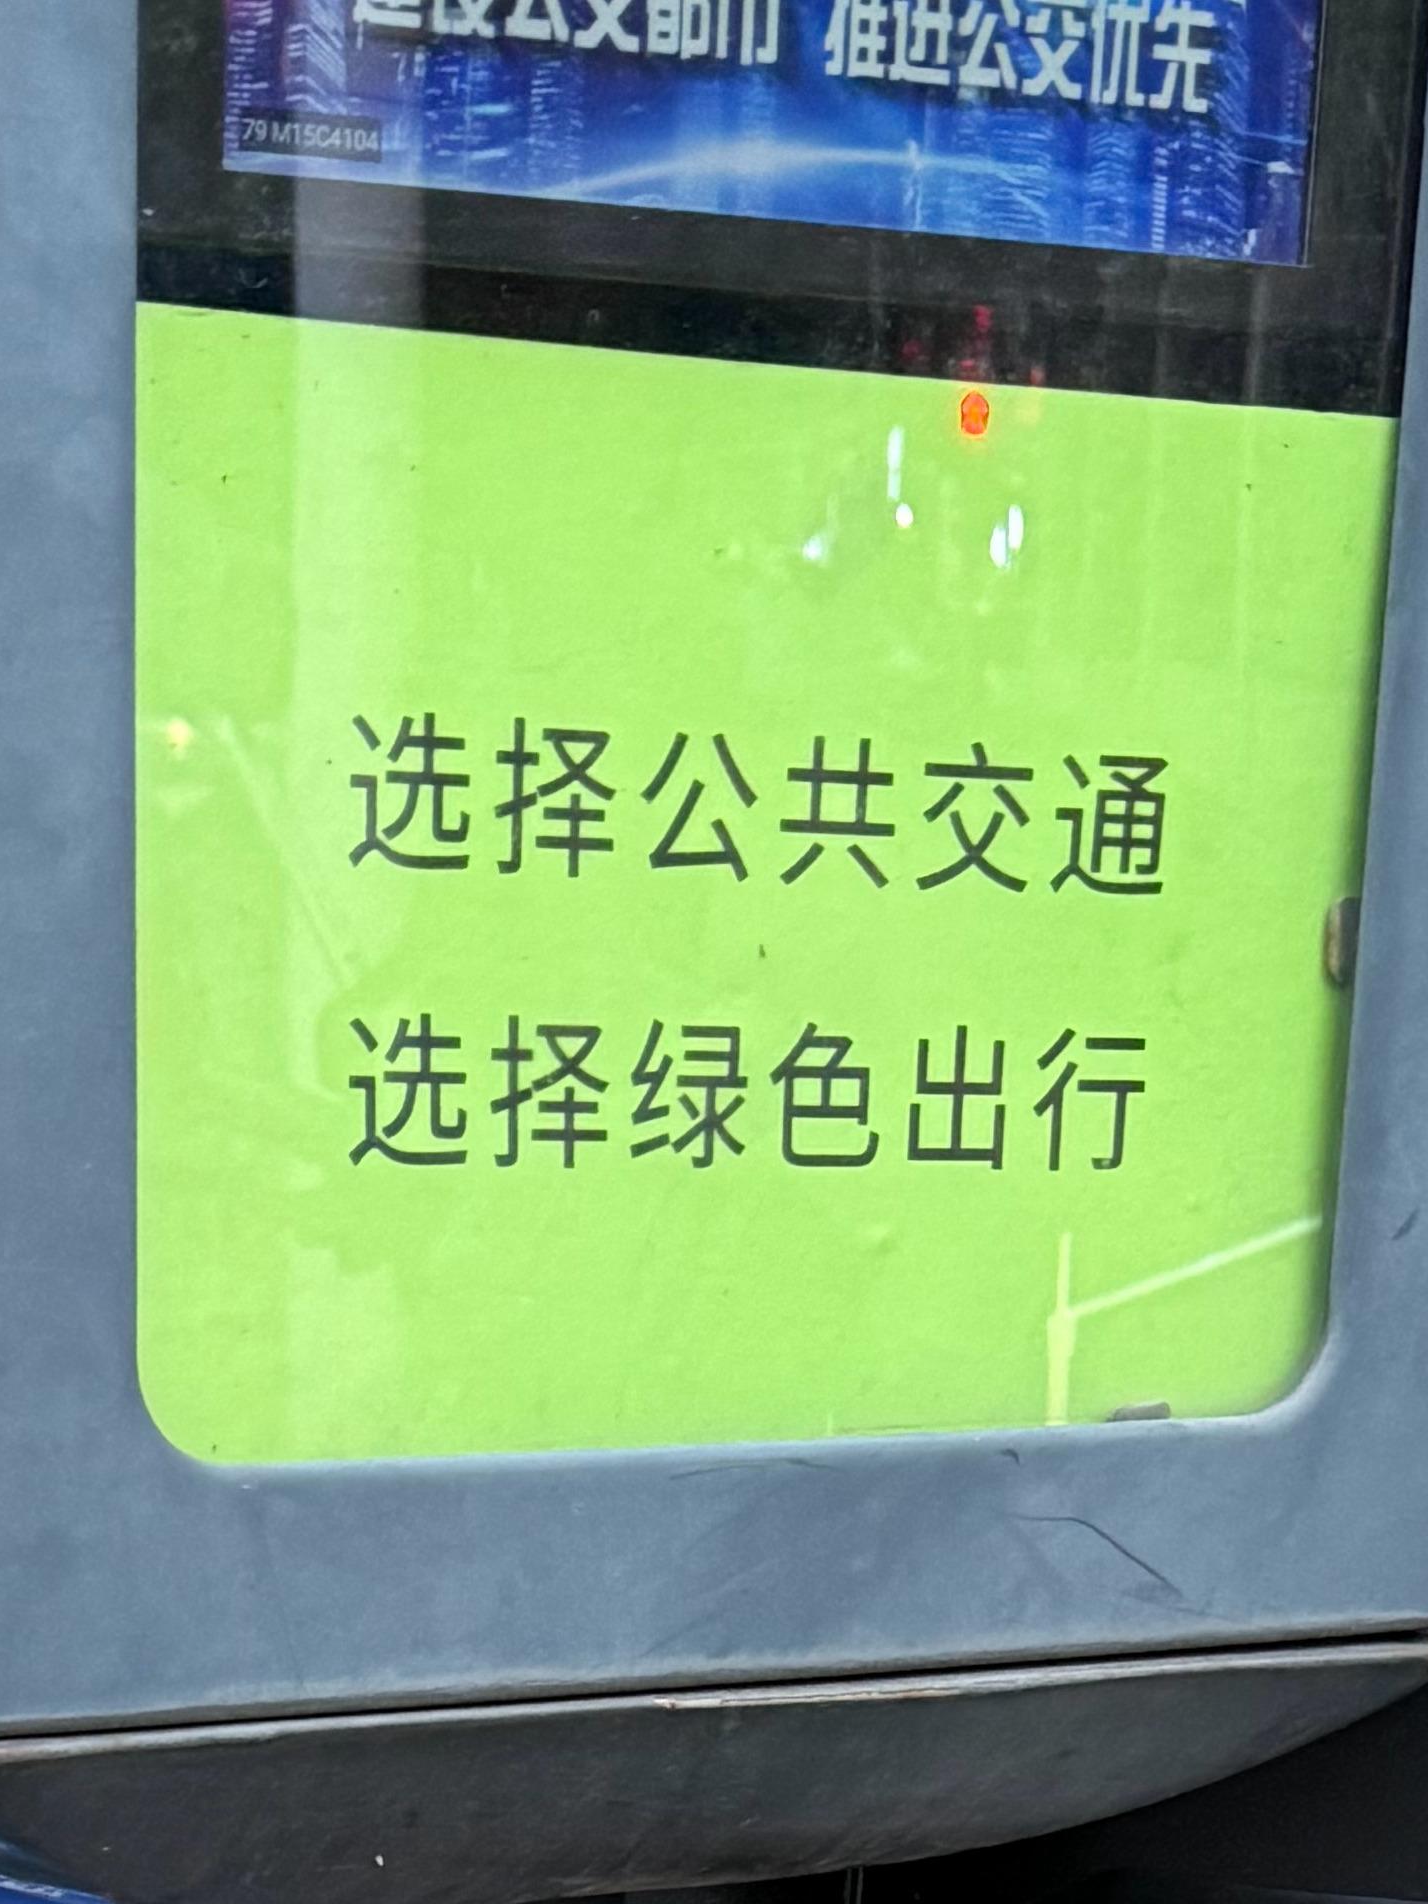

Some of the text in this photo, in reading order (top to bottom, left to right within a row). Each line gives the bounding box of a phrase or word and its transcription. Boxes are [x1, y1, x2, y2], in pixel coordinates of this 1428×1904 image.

[824, 0, 1216, 113] 推进公交优先
[241, 118, 268, 142] 79
[347, 712, 1169, 896] 选择公共交通
[347, 1012, 1146, 1173] 选择绿色出行
